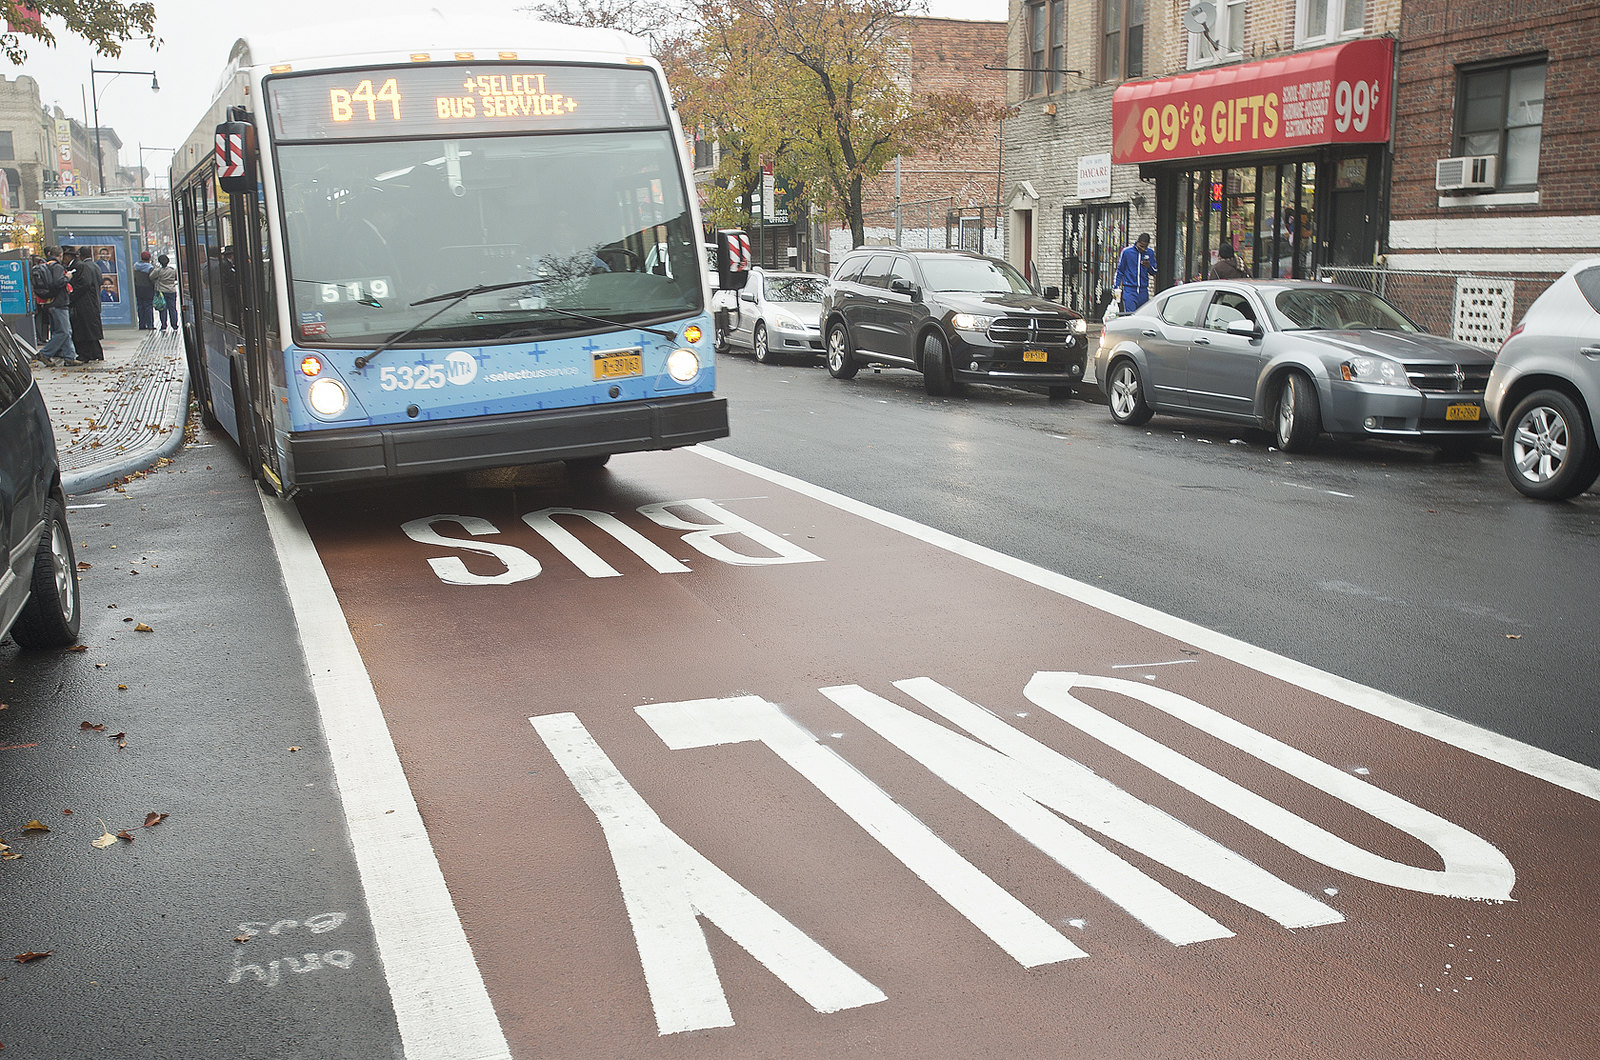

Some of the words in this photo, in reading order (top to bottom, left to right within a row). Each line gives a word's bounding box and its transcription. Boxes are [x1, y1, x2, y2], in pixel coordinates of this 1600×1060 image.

[329, 78, 402, 122] B44
[464, 73, 547, 96] +SELECT
[436, 97, 477, 119] BUS
[483, 94, 578, 117] SERVICE+
[1142, 101, 1190, 153] 99¢
[1191, 104, 1207, 147] &
[1211, 93, 1280, 144] GIFTS
[1335, 79, 1379, 133] 99¢
[1080, 166, 1108, 179] DAYCARE
[322, 280, 389, 302] 519
[380, 364, 446, 391] 5325
[401, 498, 826, 586] BUS
[529, 671, 1518, 1037] ONLY
